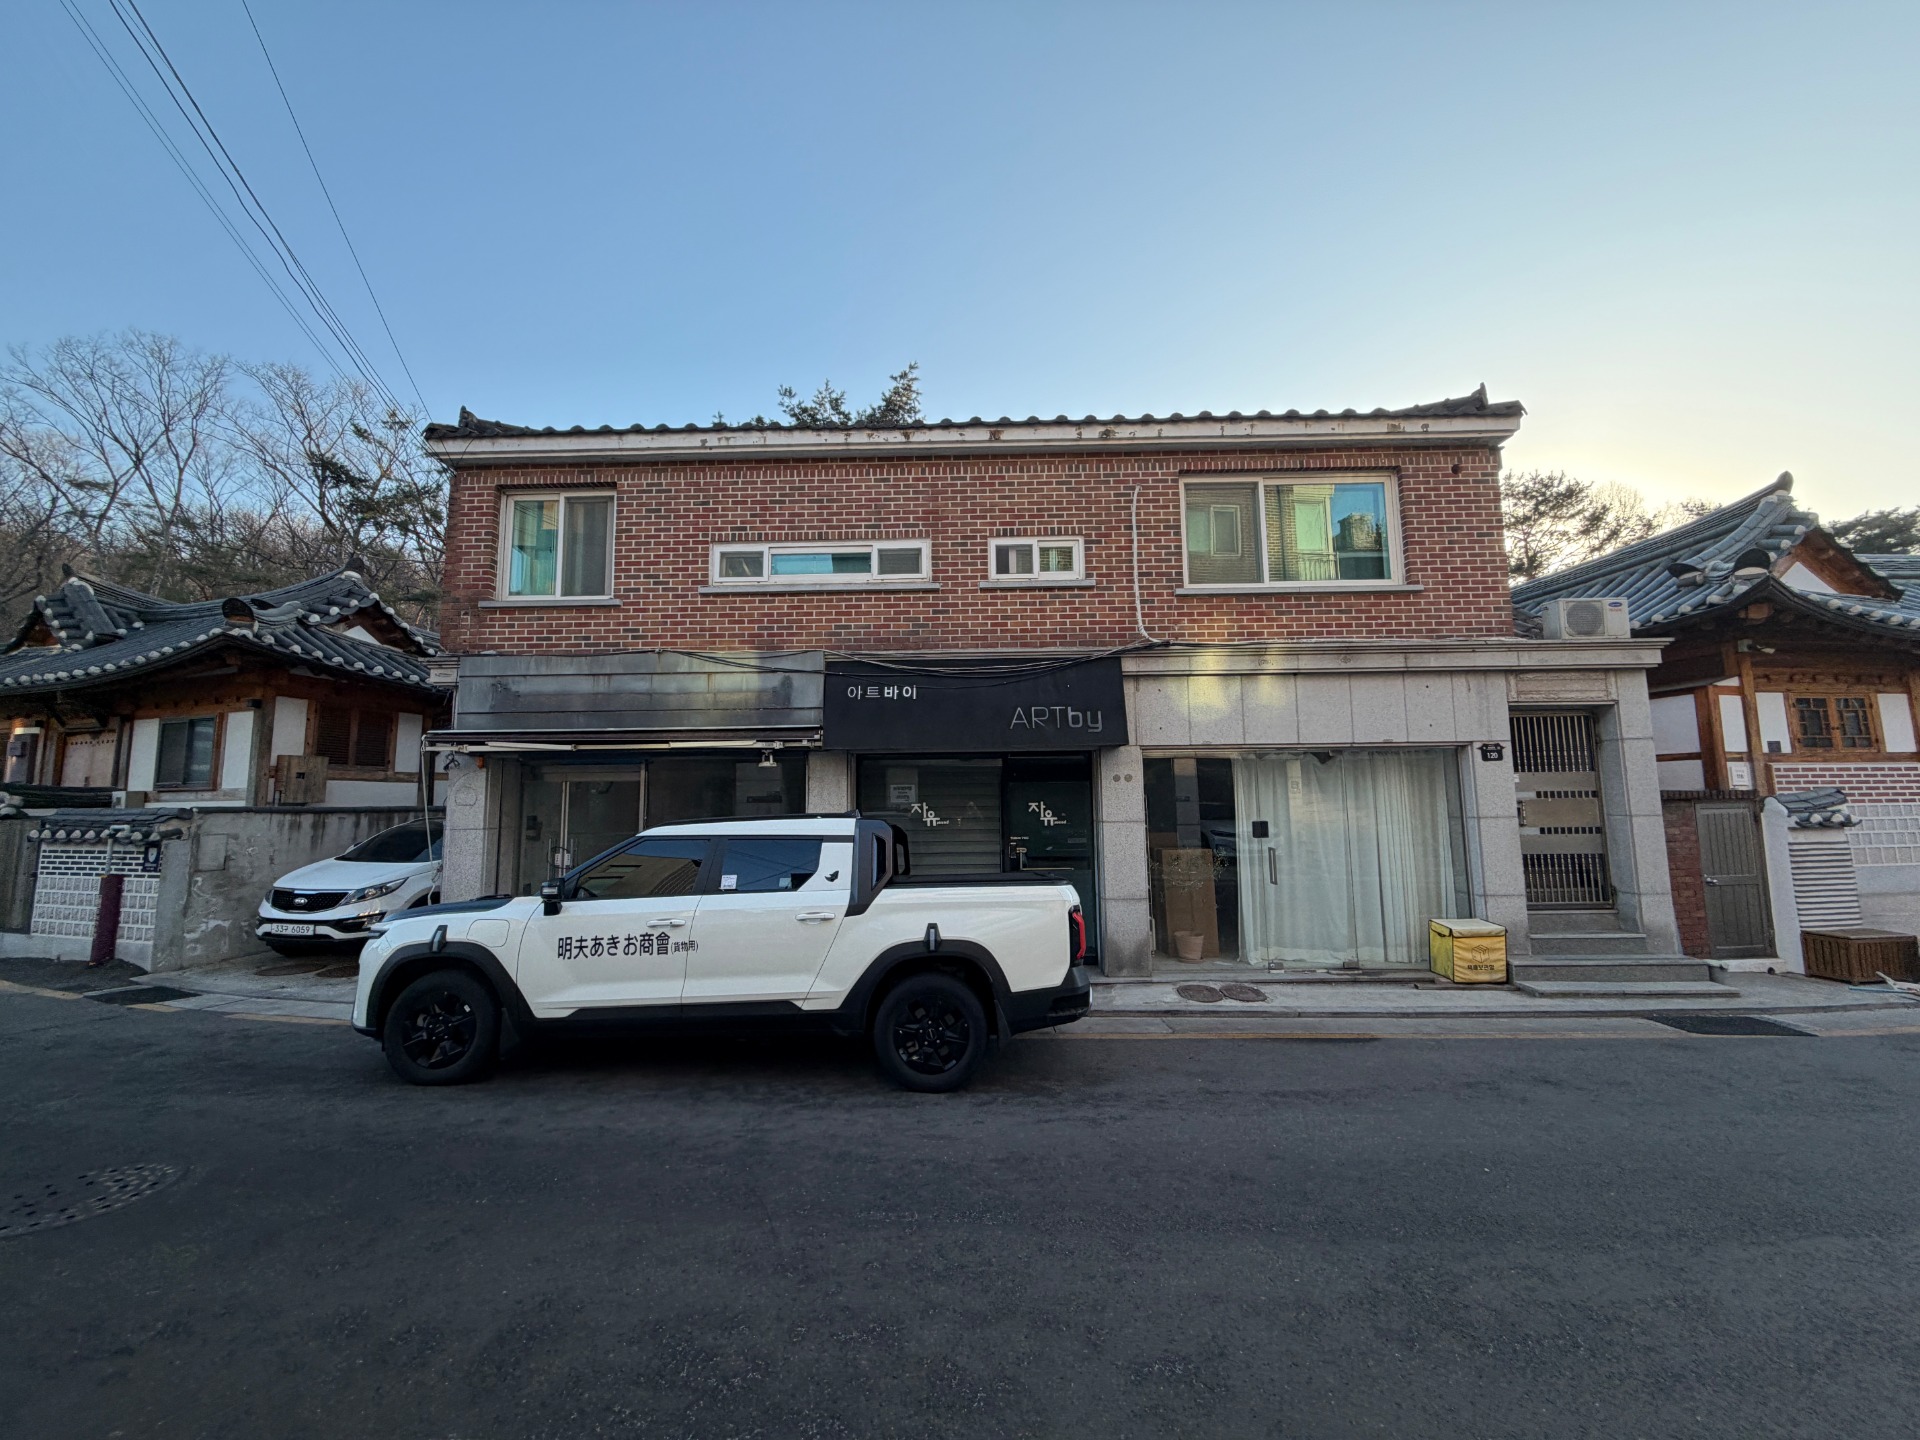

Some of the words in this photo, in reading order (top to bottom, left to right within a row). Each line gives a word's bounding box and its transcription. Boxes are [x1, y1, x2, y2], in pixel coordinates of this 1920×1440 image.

[847, 685, 917, 700] 아트바이
[1009, 706, 1103, 732] ARTby
[911, 802, 940, 827] 자유
[1028, 801, 1058, 826] 자유
[291, 926, 310, 934] 6059
